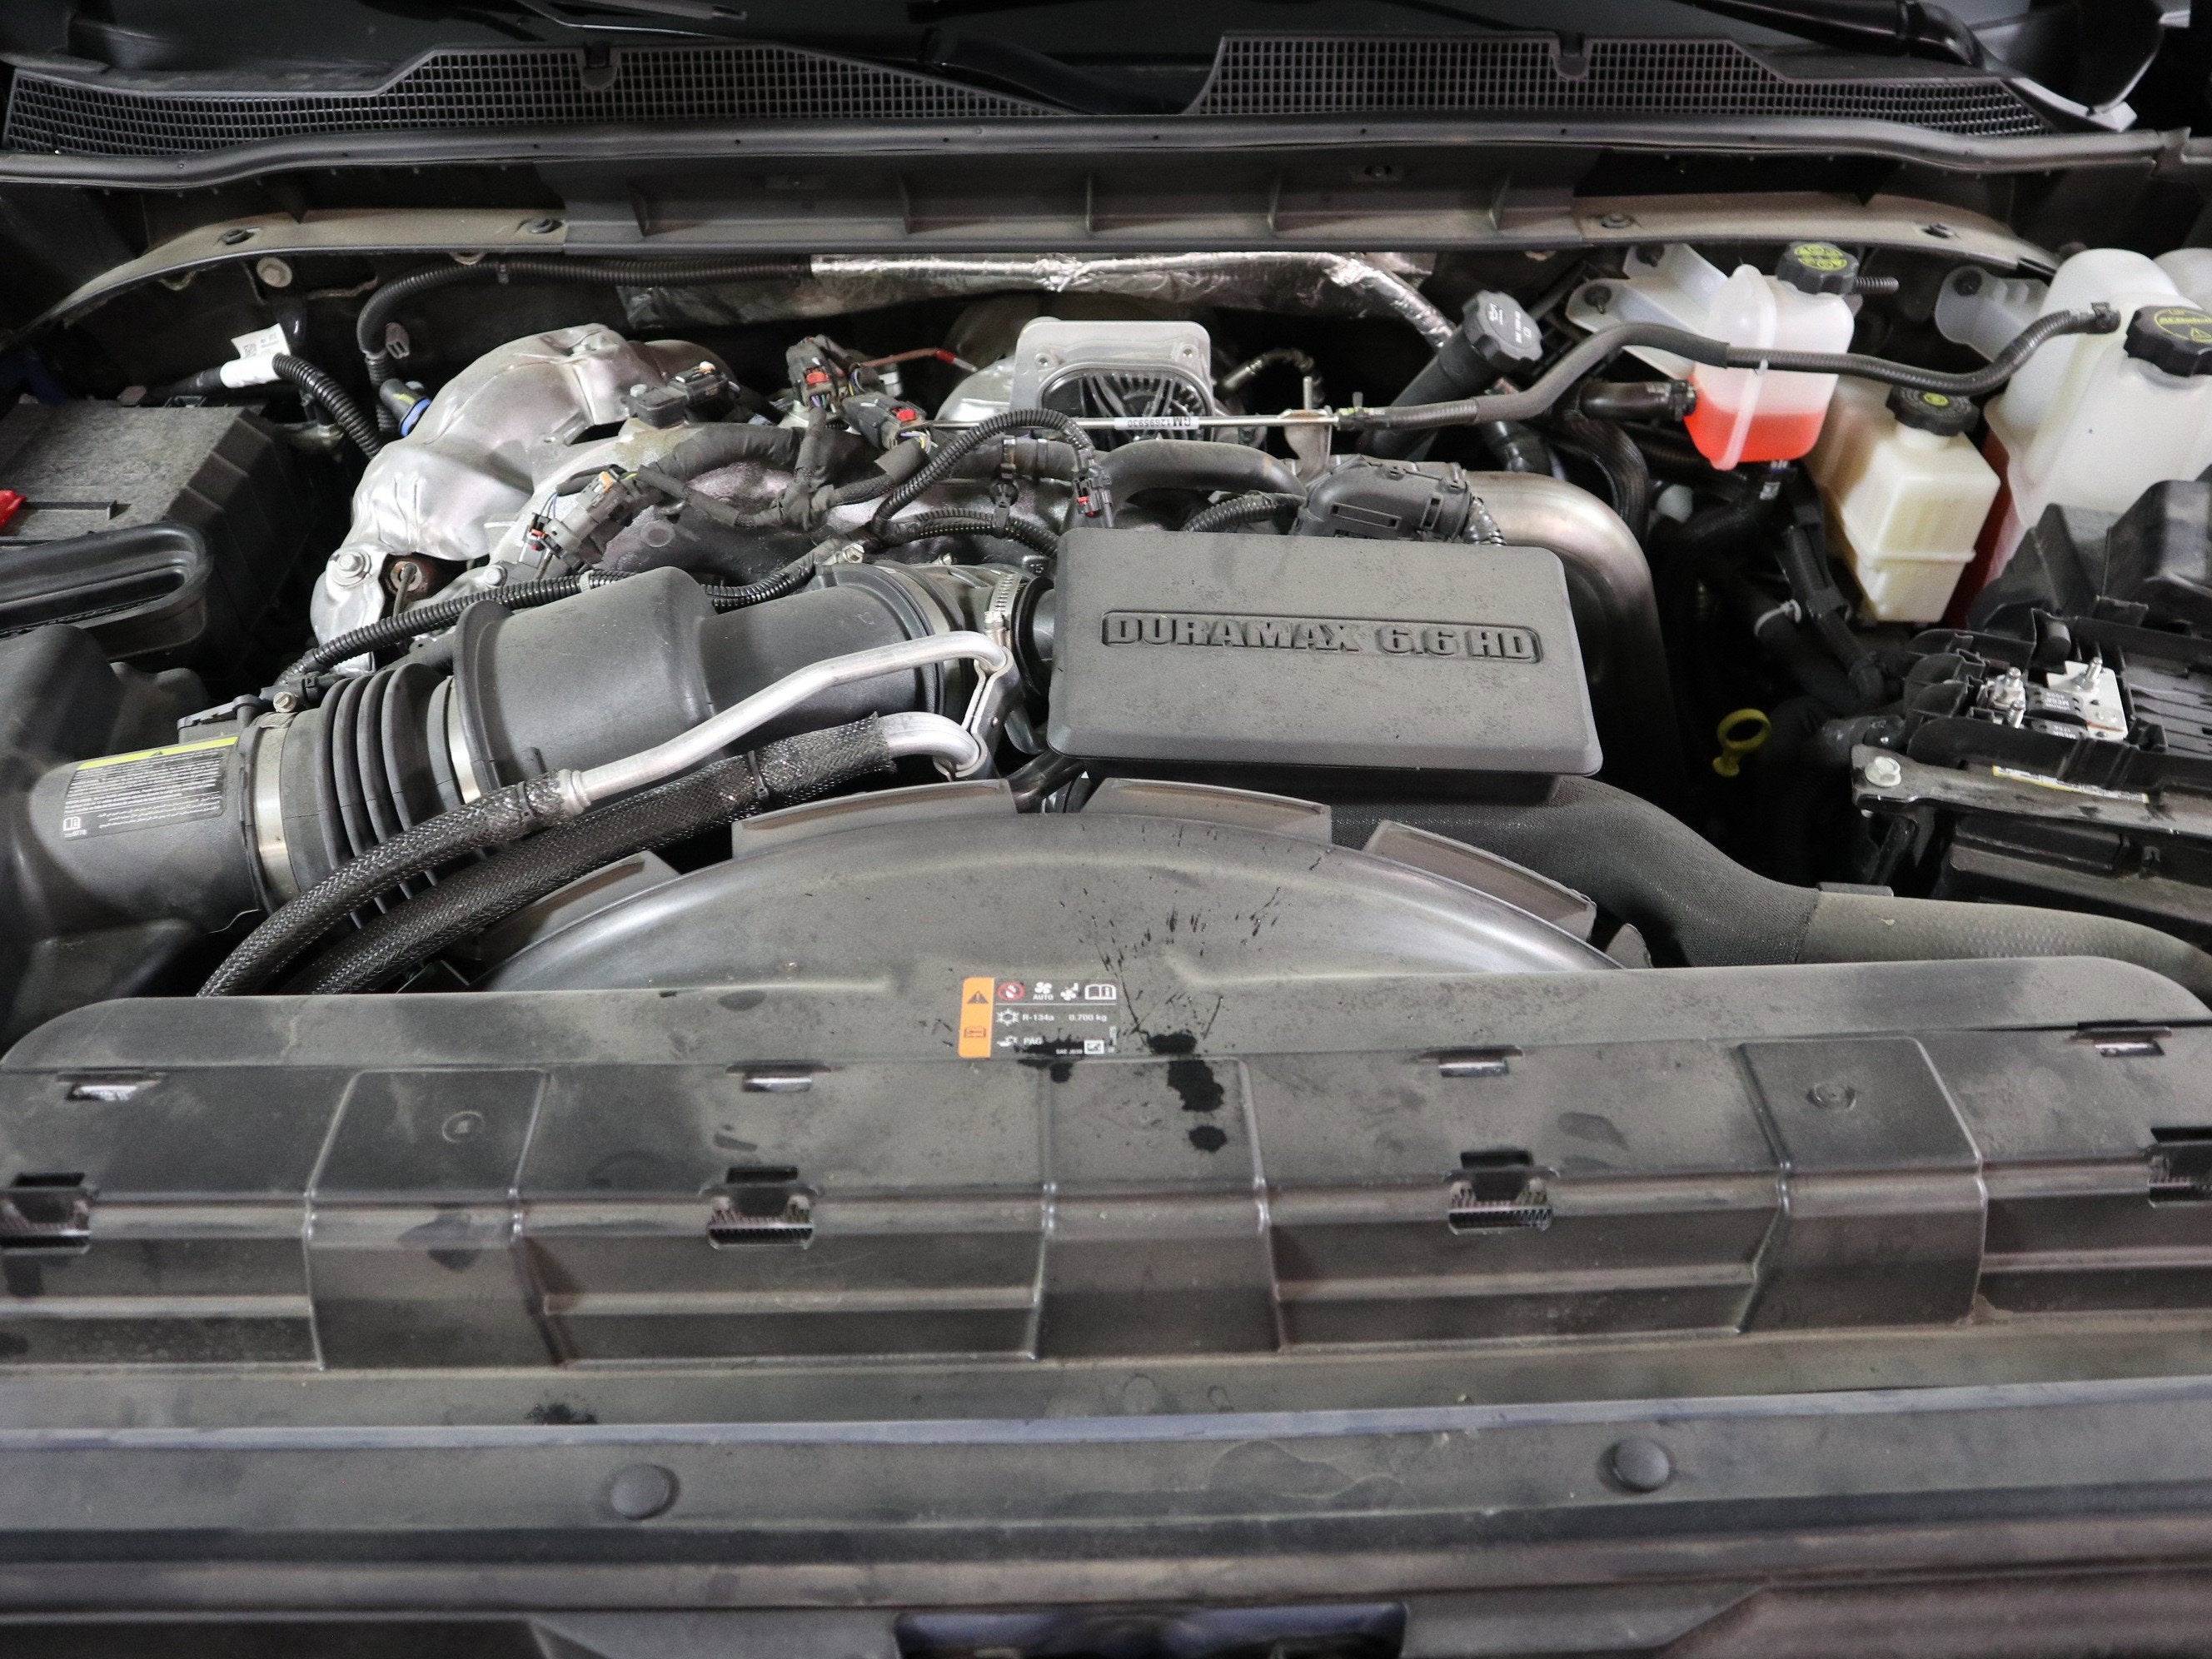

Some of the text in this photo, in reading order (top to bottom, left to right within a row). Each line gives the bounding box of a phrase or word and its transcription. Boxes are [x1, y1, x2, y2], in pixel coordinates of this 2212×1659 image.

[1172, 416, 1191, 426] GM
[1108, 615, 1537, 660] DURAMAX 6.6 HD
[1022, 1014, 1108, 1023] R-134a 0.700 kg
